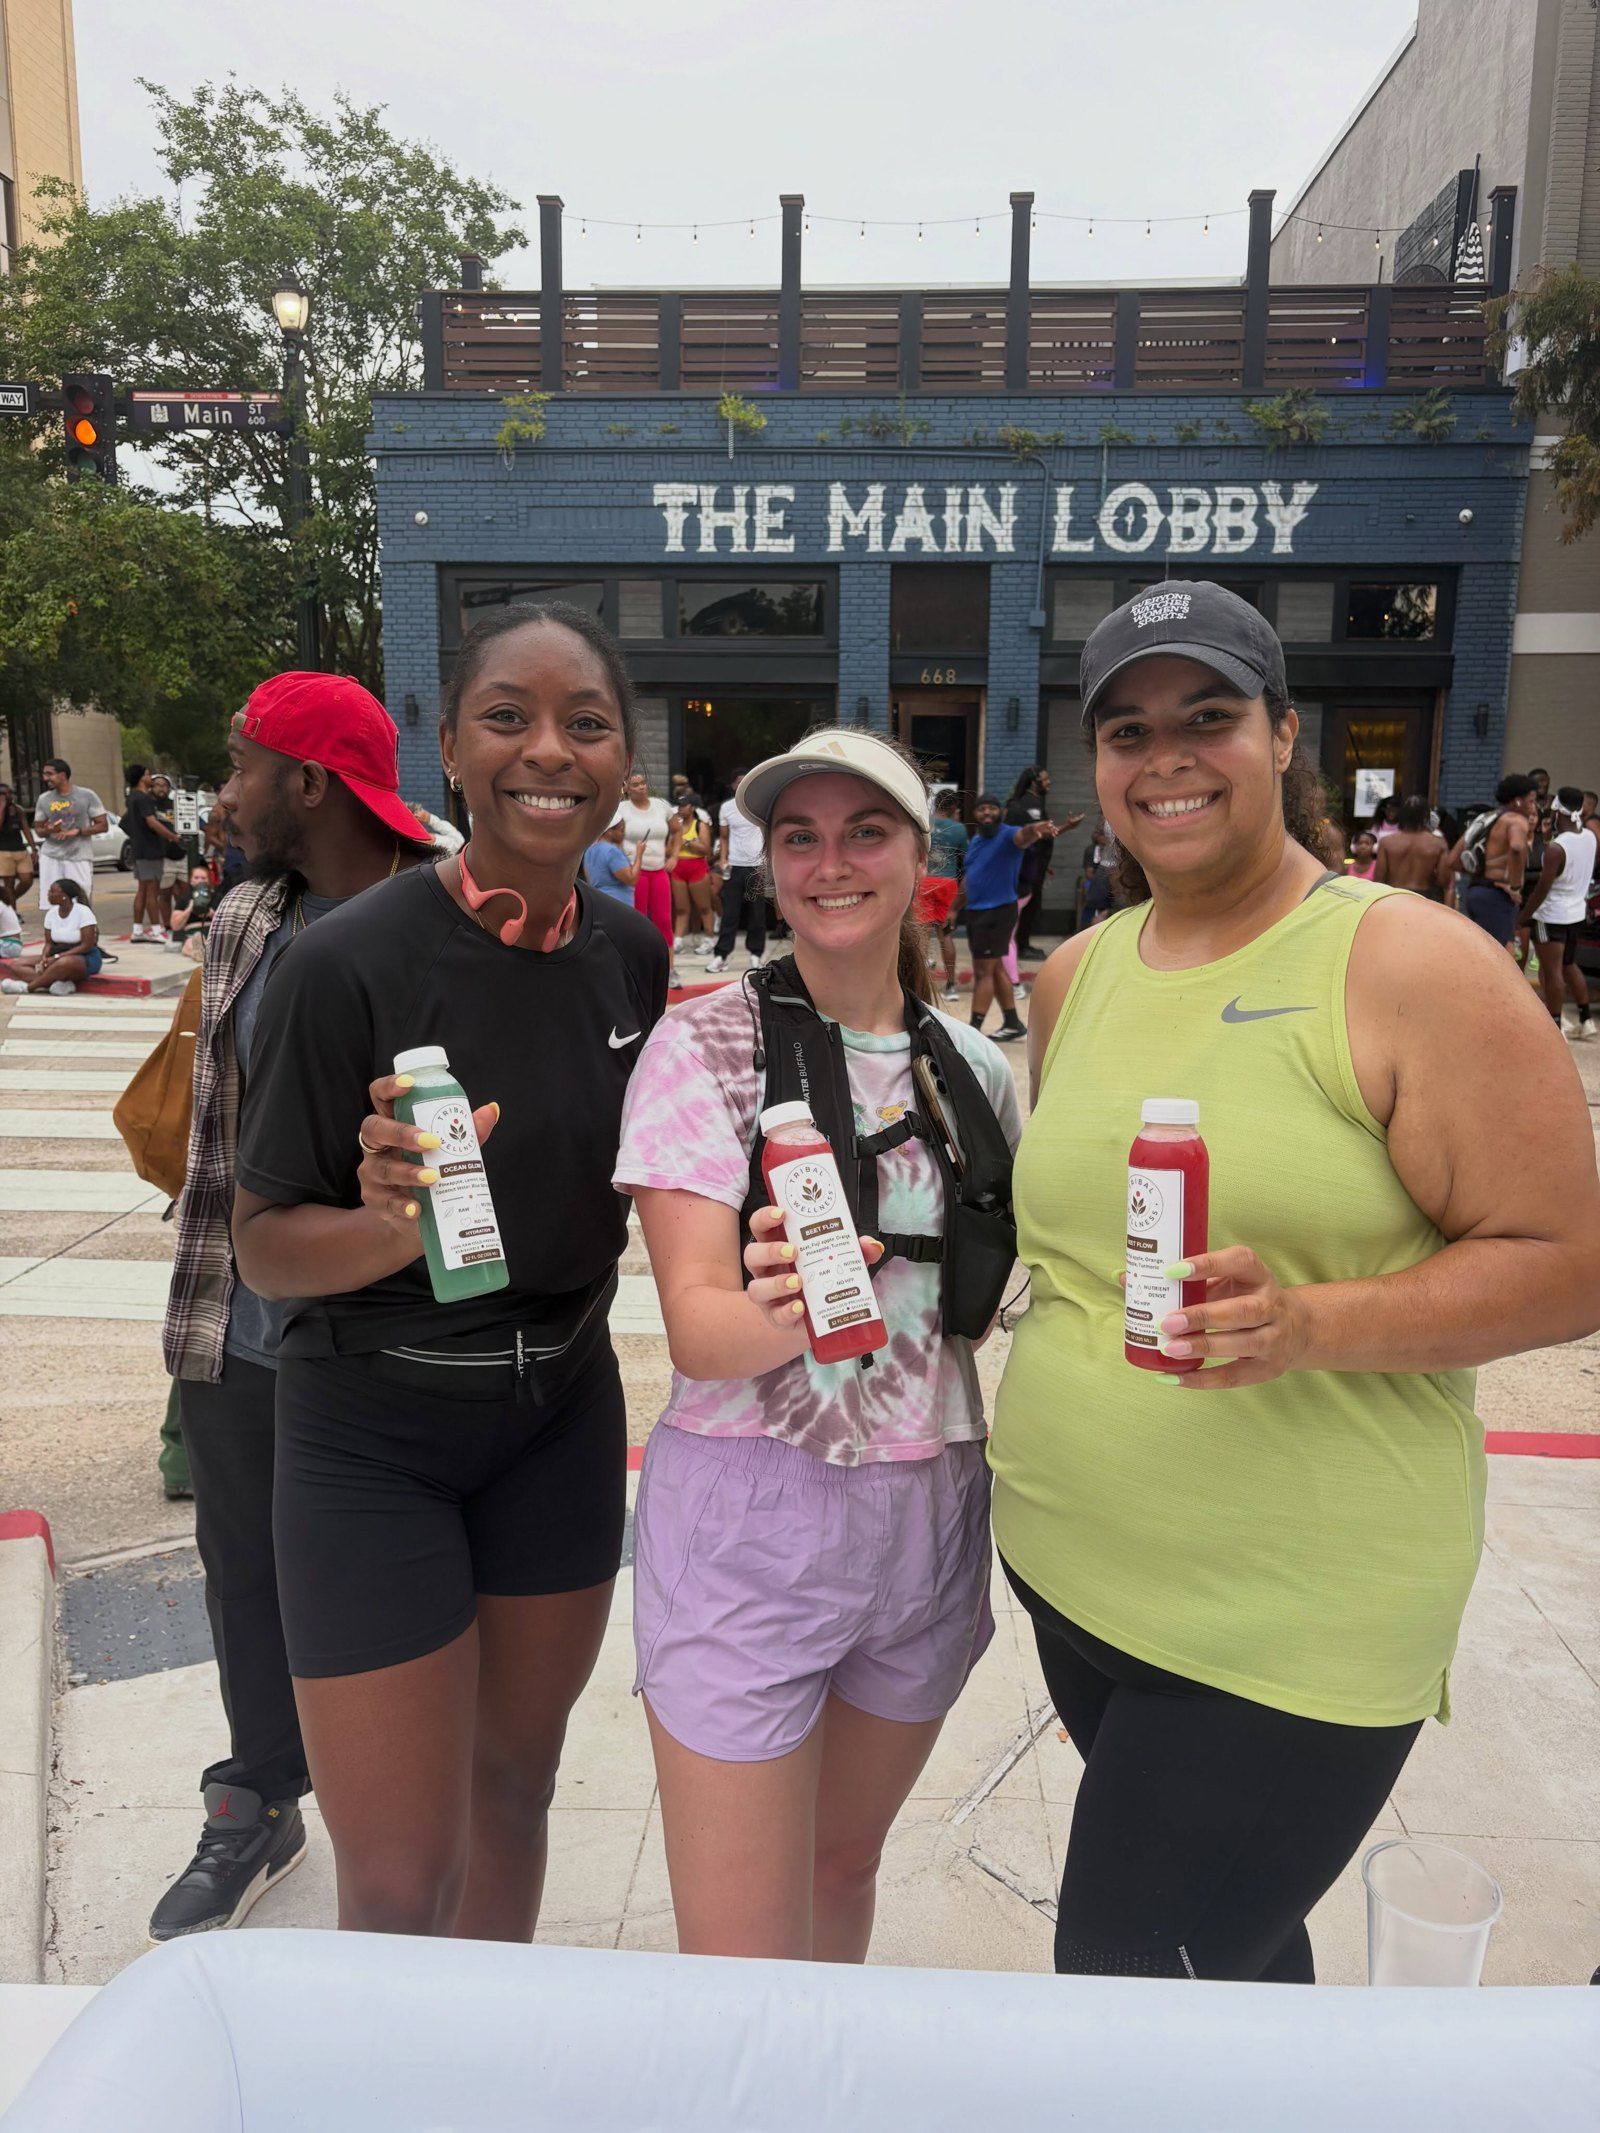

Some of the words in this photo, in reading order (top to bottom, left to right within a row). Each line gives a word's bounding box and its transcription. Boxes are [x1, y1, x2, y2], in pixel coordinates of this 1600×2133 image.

[1, 393, 21, 405] WAY
[184, 403, 233, 424] Main
[248, 404, 263, 415] ST
[247, 416, 266, 425] 600
[653, 483, 795, 553] THE
[826, 481, 1018, 553] MAIN
[1051, 480, 1320, 554] LOBBY
[1131, 593, 1191, 612] EVERYONE
[1132, 600, 1190, 616] WATCHES
[1133, 605, 1190, 622] WOMEN'S
[1137, 612, 1187, 628] SPORTS.
[921, 669, 956, 684] 668
[794, 1042, 807, 1077] BUFFALO
[443, 1164, 467, 1174] OCEAN
[790, 1166, 824, 1183] TRIBAL
[793, 1190, 834, 1213] WELLNESS
[805, 1226, 822, 1236] BEET
[822, 1222, 840, 1231] FLOW
[1136, 1241, 1154, 1250] FLOW
[1138, 1262, 1160, 1270] Turmeric
[1145, 1256, 1165, 1264] Orange,
[827, 1288, 858, 1302] ENDURANCE
